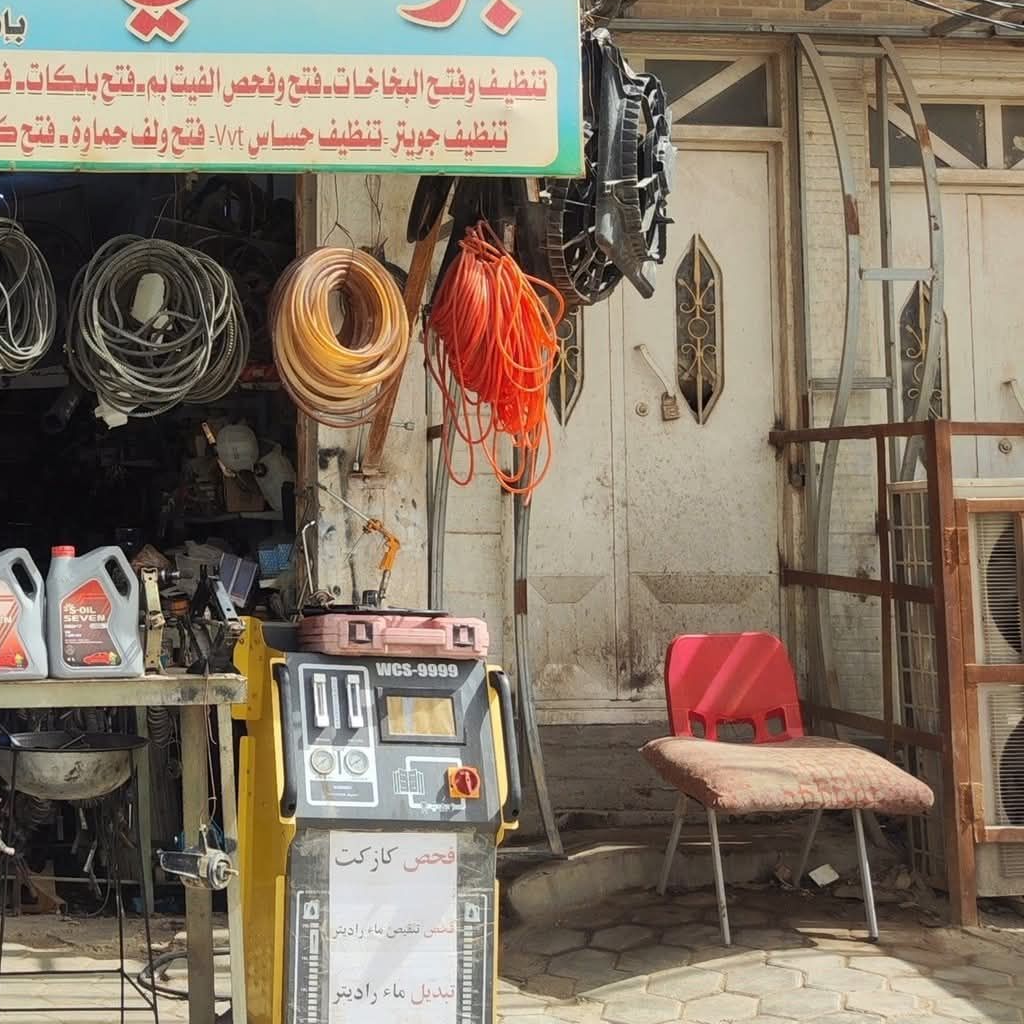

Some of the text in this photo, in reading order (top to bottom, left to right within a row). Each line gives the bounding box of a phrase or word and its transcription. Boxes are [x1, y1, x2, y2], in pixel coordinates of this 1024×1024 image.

[478, 68, 548, 105] تنظيف
[248, 120, 315, 156] حساس
[443, 119, 508, 157] تنظيف
[63, 614, 106, 622] SEVEN
[375, 662, 459, 678] WCS-9999
[403, 846, 456, 872] فحص
[333, 982, 455, 1005] تبديل ماء راديتر
